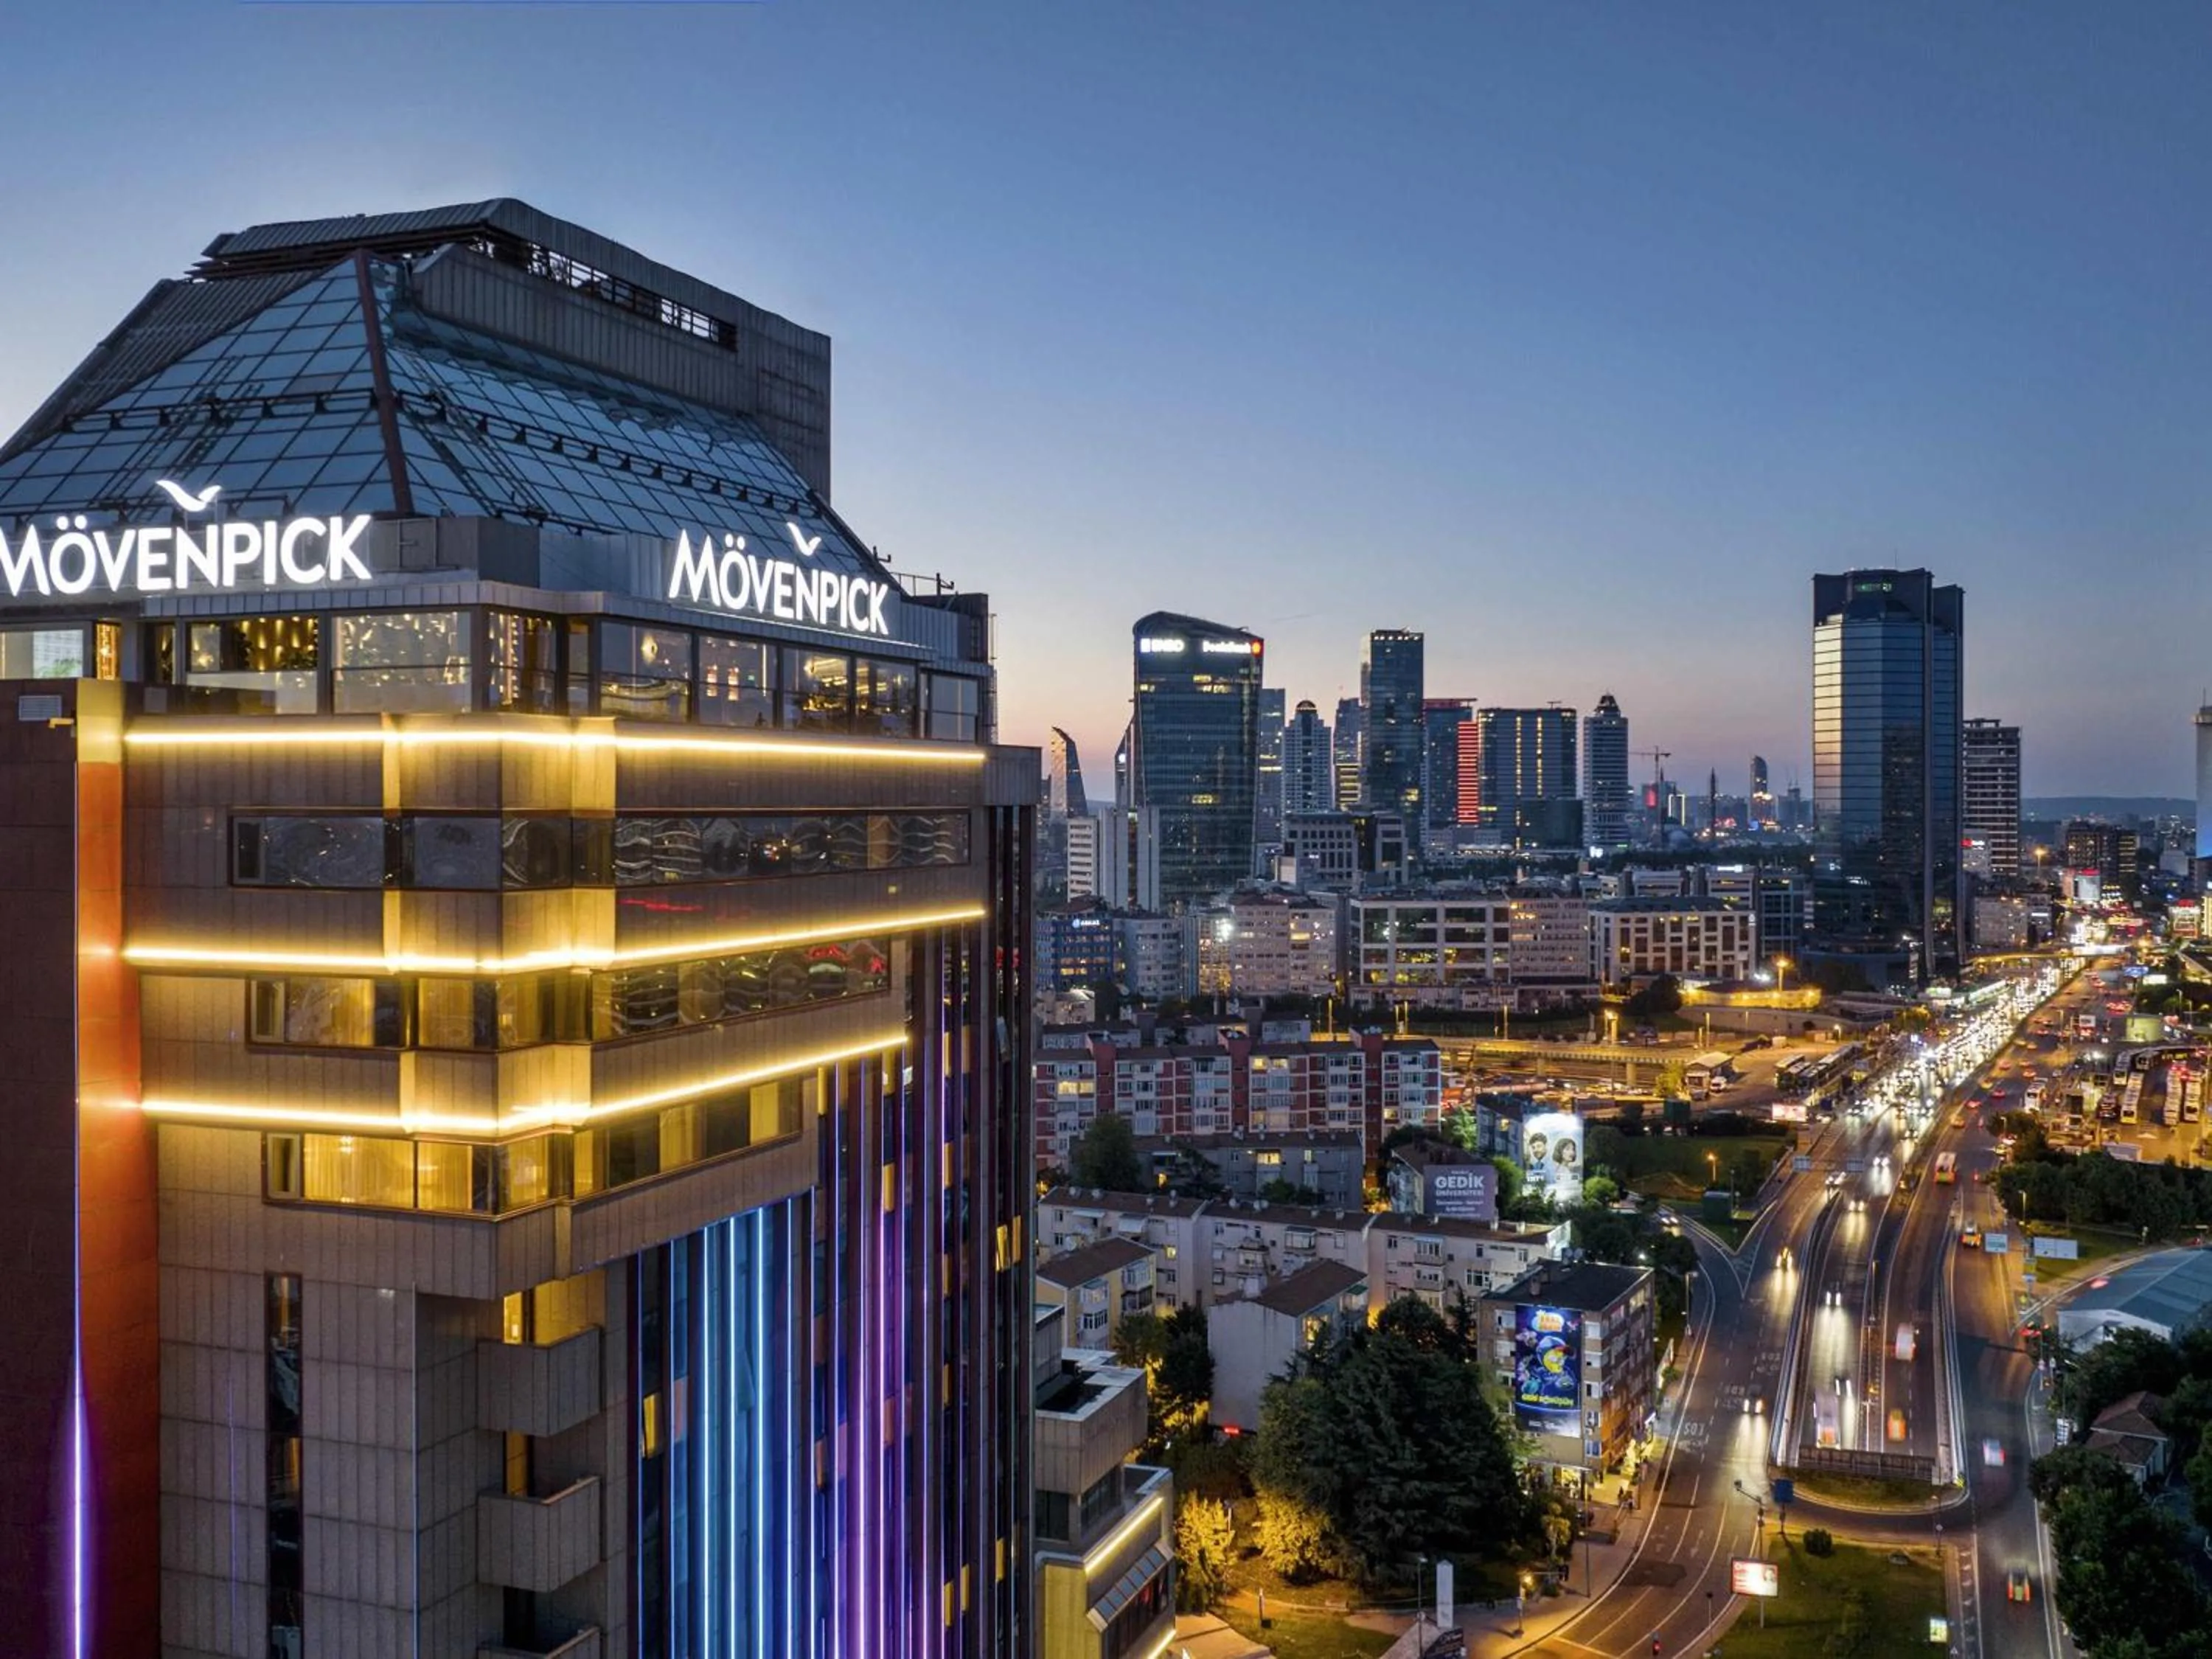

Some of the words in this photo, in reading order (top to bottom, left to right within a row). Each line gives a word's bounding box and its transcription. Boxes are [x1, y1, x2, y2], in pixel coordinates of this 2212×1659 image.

[0, 515, 372, 597] MÖVENPICK
[668, 529, 889, 635] MÖVENPICK
[1435, 1172, 1484, 1189] GEDİK
